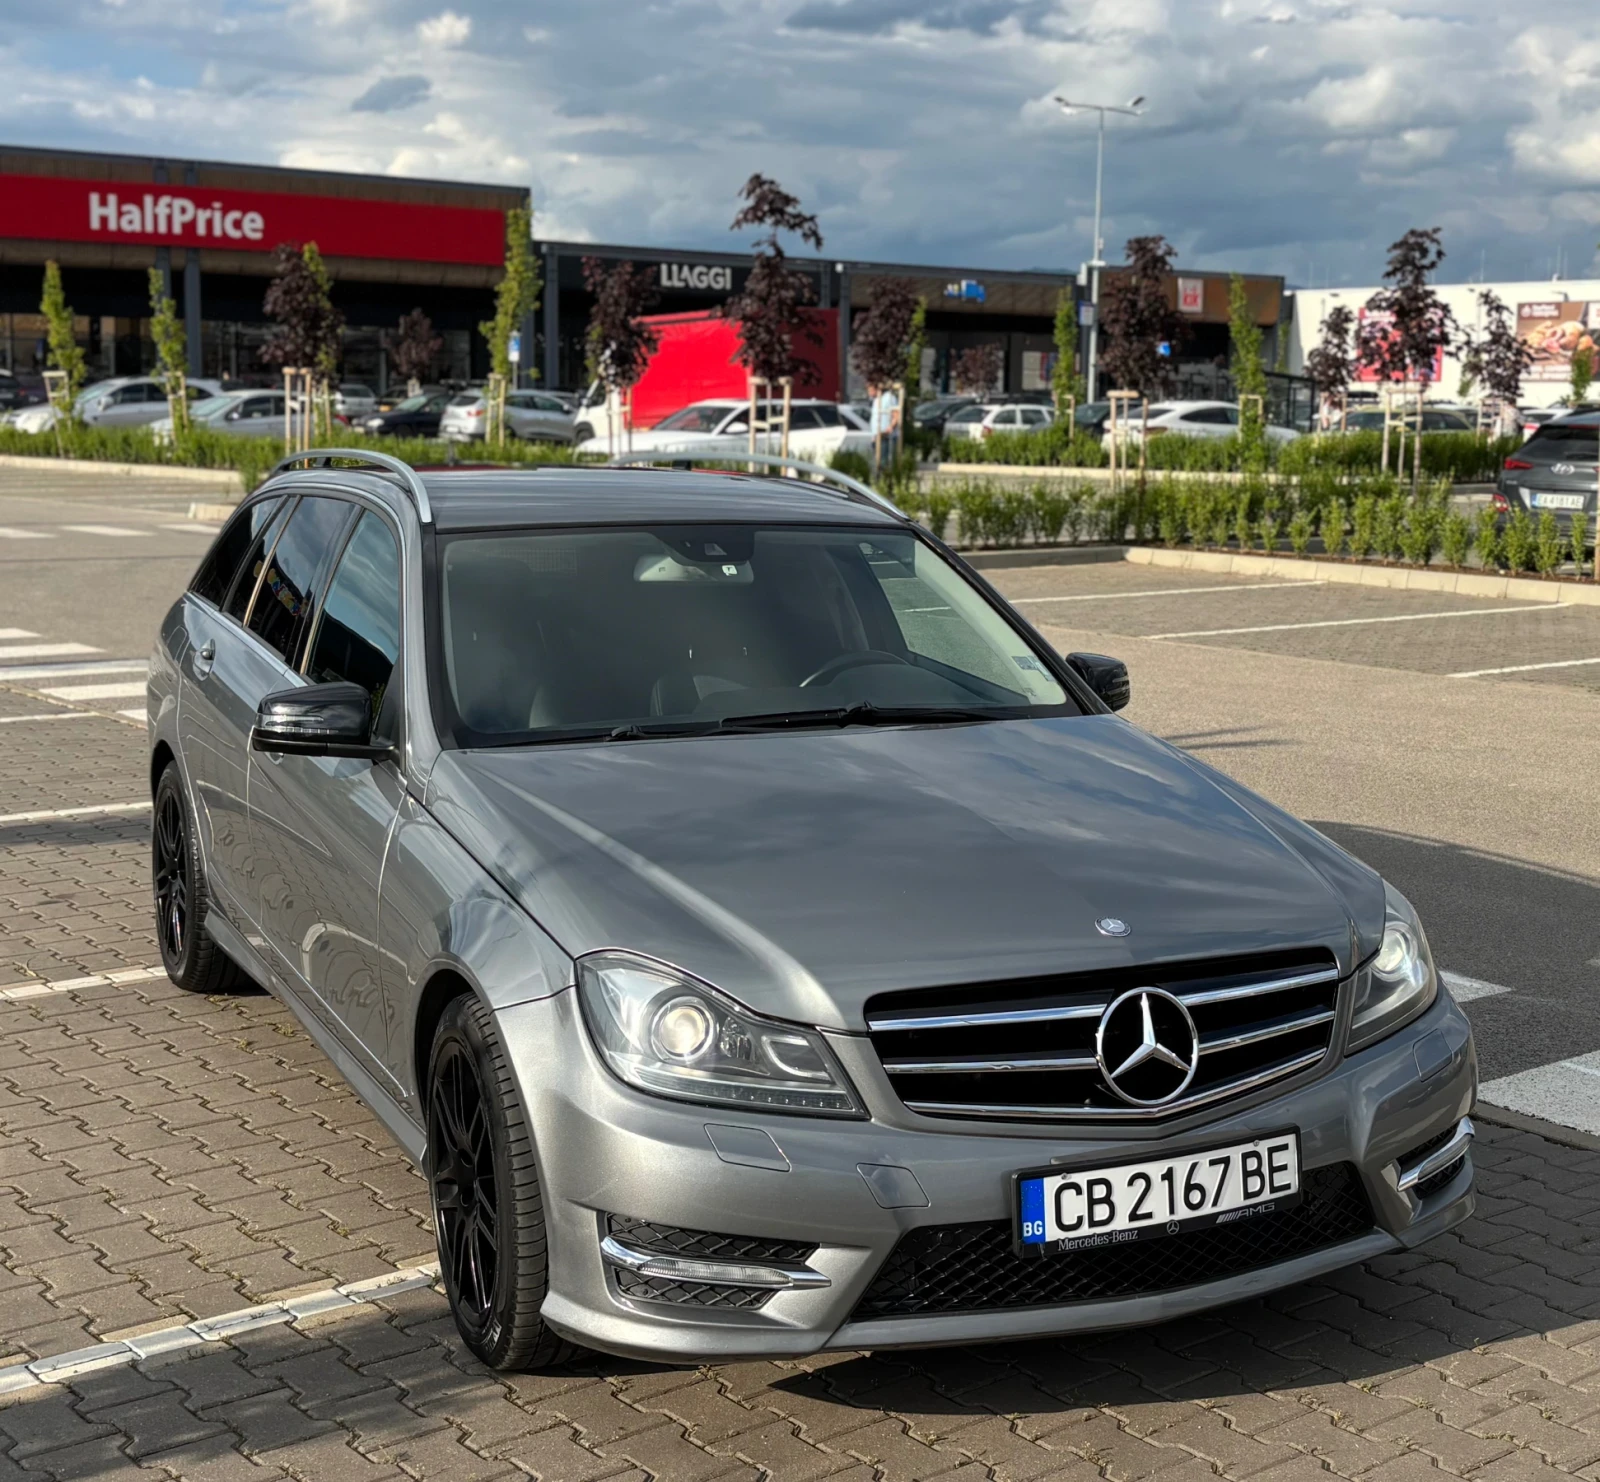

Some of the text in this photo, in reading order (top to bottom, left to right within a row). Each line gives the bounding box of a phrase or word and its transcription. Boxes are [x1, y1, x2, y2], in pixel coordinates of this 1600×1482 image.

[88, 191, 265, 240] HalfPrice
[660, 263, 732, 291] LLAGGI
[1054, 1143, 1291, 1232] CB 2167 BE
[1023, 1221, 1043, 1237] BG
[1058, 1230, 1138, 1251] Mercedes-Benz
